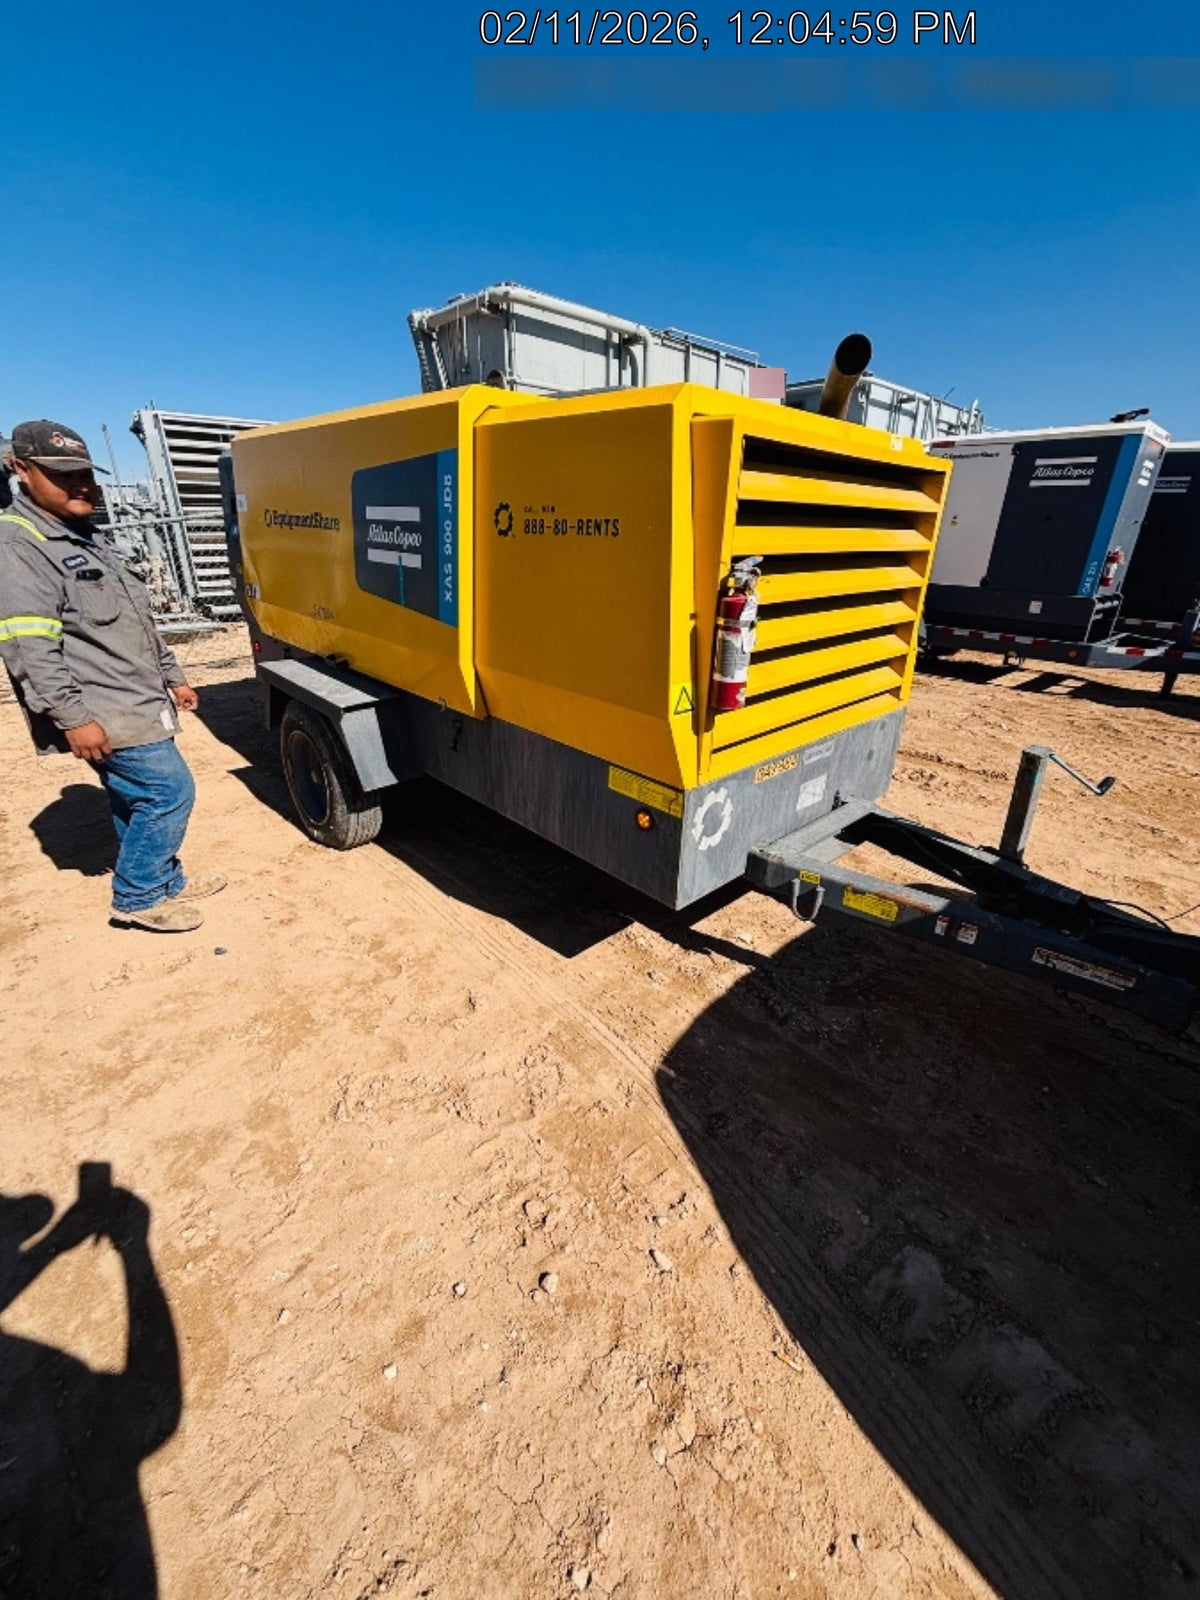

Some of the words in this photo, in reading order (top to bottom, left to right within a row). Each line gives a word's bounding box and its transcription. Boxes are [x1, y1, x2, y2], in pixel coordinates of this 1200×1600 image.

[367, 523, 394, 545] Atlas
[394, 524, 422, 550] Copco
[443, 522, 453, 555] 900
[523, 518, 620, 537] 888-80-RENTS
[443, 563, 453, 603] XAS
